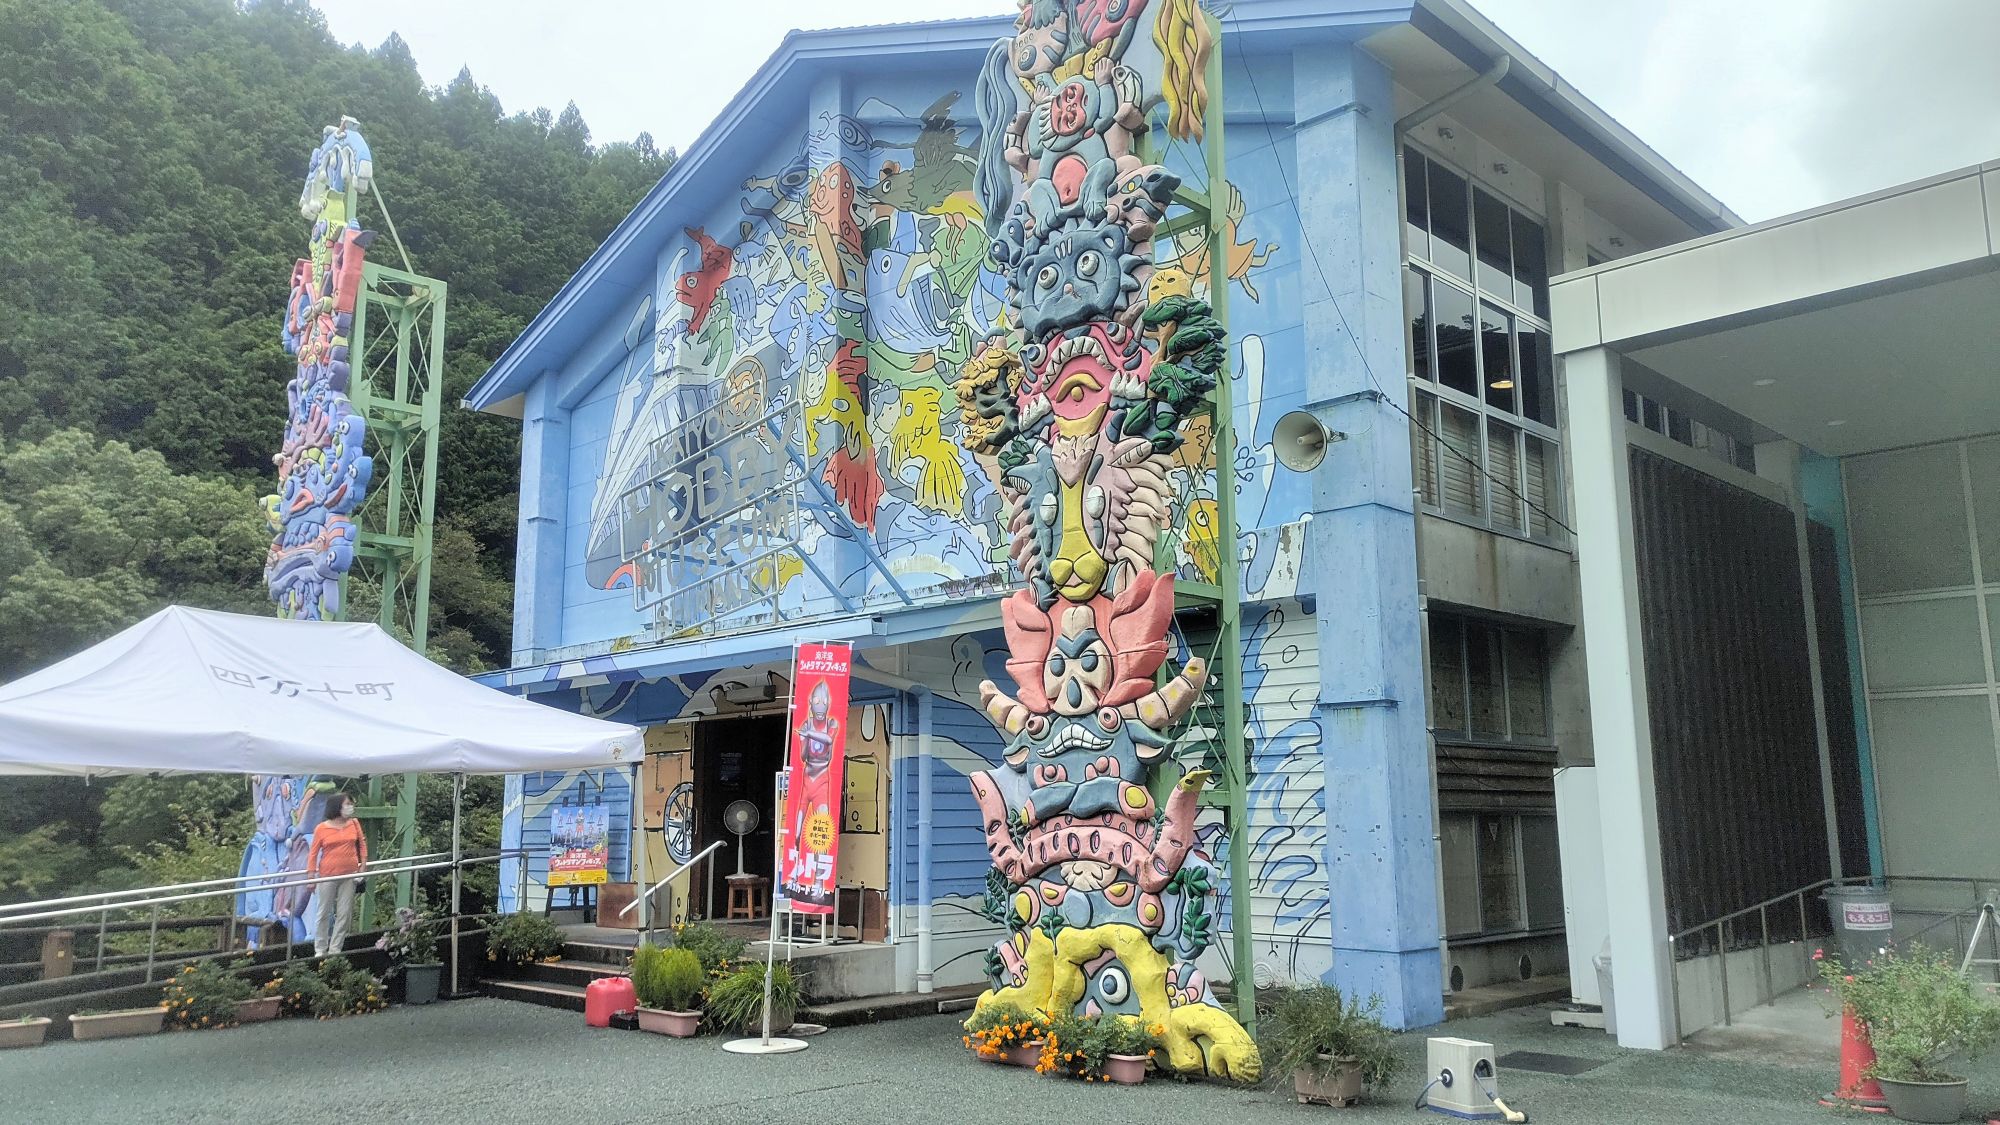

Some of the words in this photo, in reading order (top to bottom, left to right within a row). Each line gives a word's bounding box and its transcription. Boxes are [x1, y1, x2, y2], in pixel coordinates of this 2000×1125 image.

[626, 410, 797, 545] HOBBY
[638, 496, 790, 602] MUSEUM
[209, 664, 395, 702] 四万十町
[788, 846, 834, 880] ウルトラ
